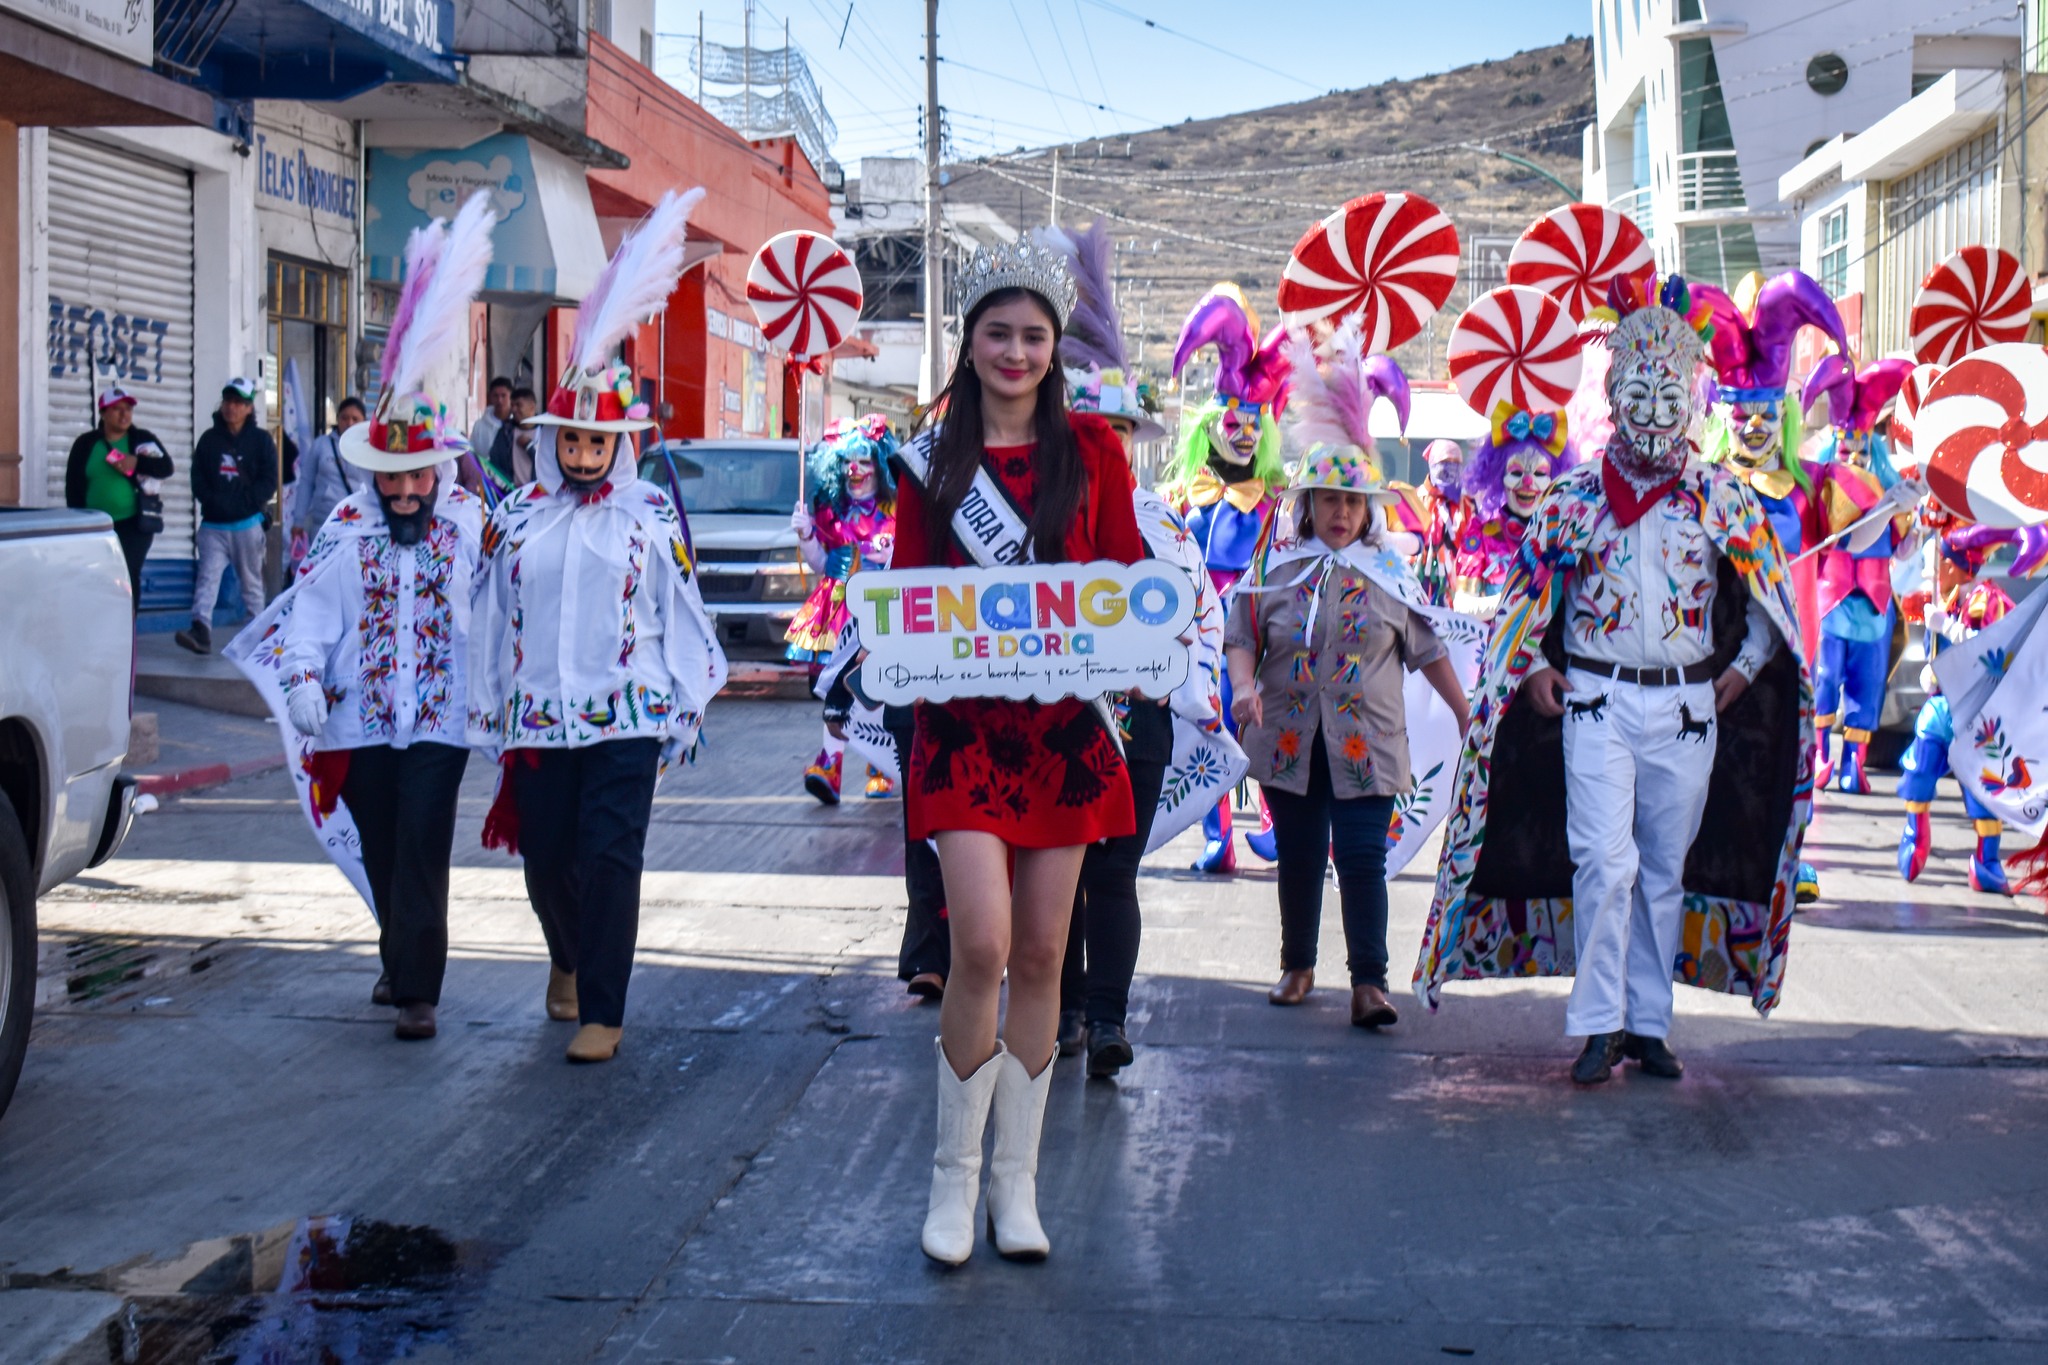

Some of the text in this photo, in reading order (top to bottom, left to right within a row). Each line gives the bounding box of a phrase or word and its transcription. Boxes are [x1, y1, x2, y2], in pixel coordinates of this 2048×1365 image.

[414, 0, 442, 54] SOL
[426, 173, 453, 184] Moda
[953, 636, 989, 659] DE
[961, 671, 982, 680] se
[988, 661, 1038, 683] borda
[1044, 669, 1051, 685] y
[1059, 668, 1080, 676] se
